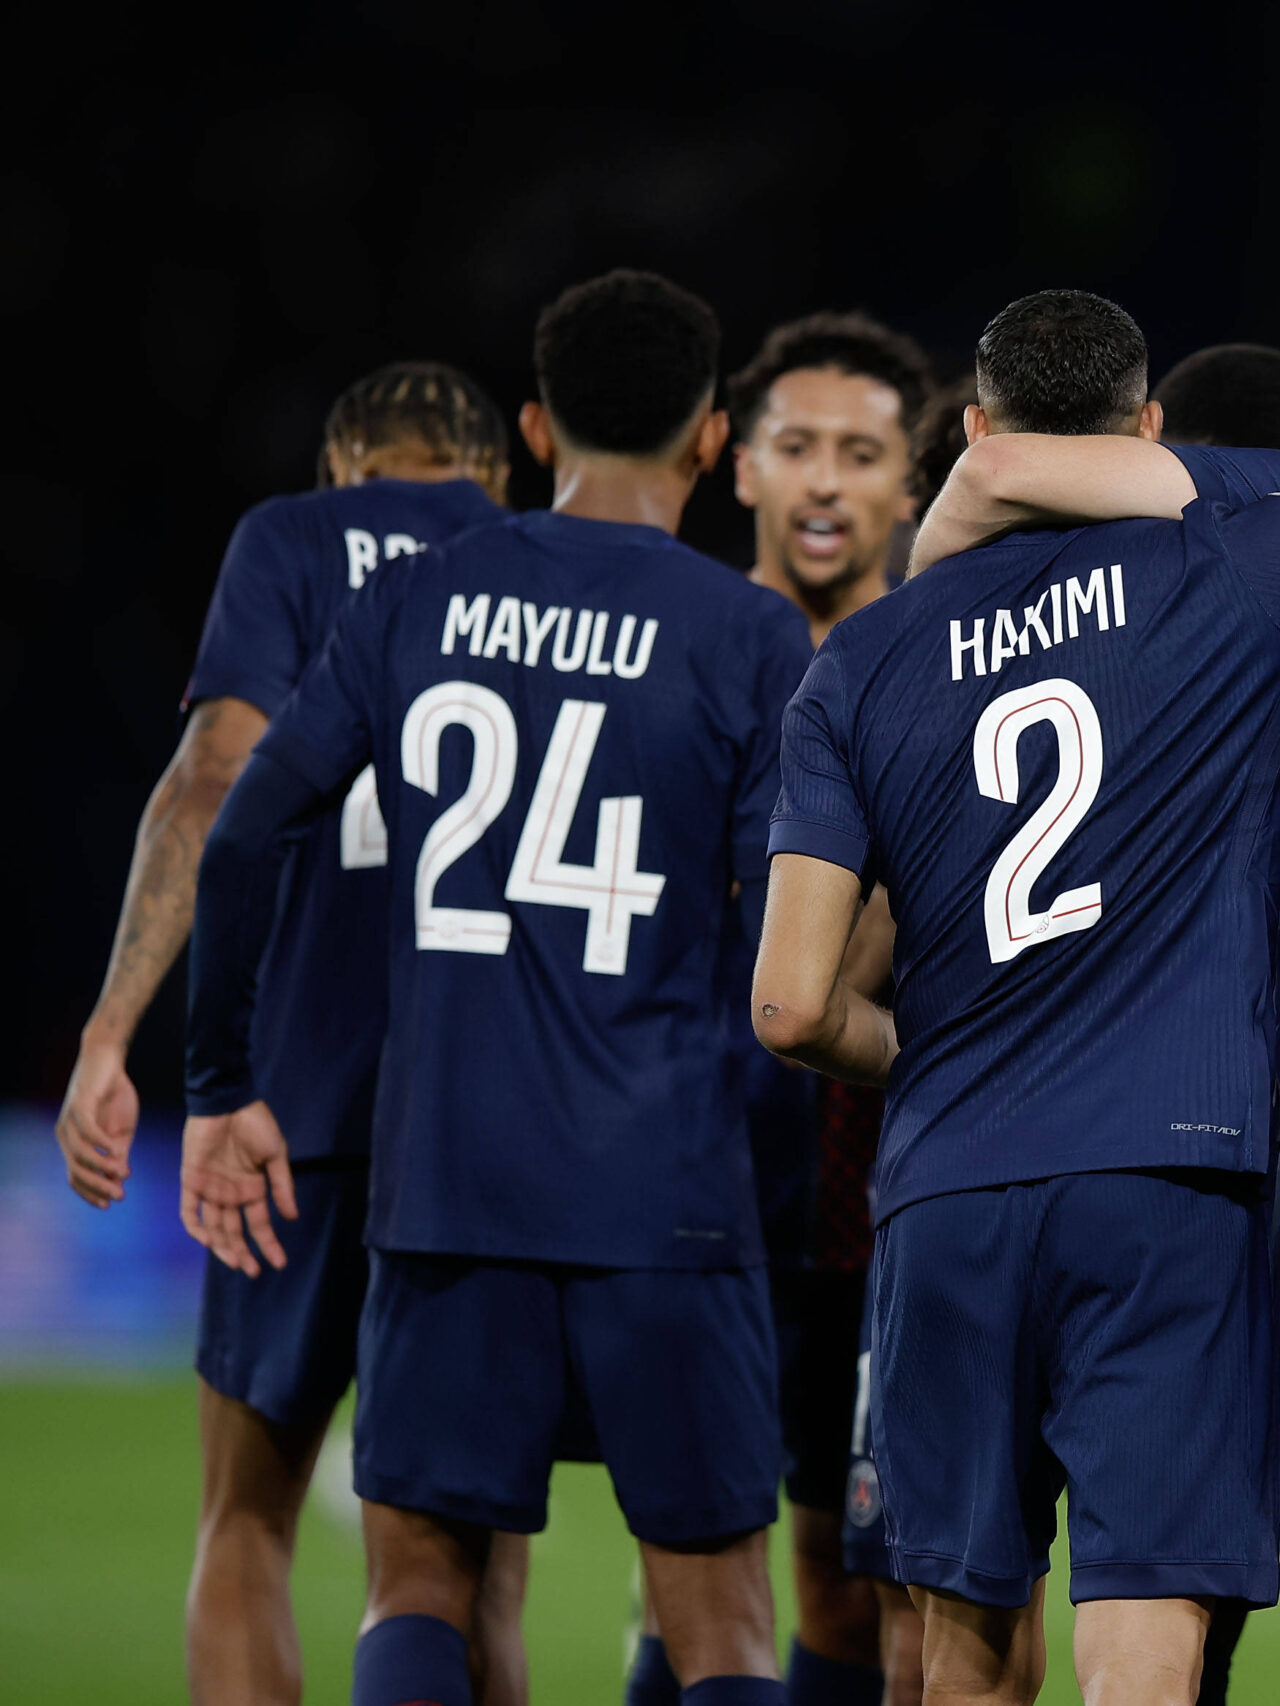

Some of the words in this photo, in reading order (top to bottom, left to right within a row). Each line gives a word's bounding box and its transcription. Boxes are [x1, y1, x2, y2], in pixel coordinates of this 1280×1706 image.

[441, 593, 659, 680] MAYULU
[950, 564, 1126, 681] HAKIMI
[401, 680, 666, 976] 24
[973, 677, 1104, 964] 2
